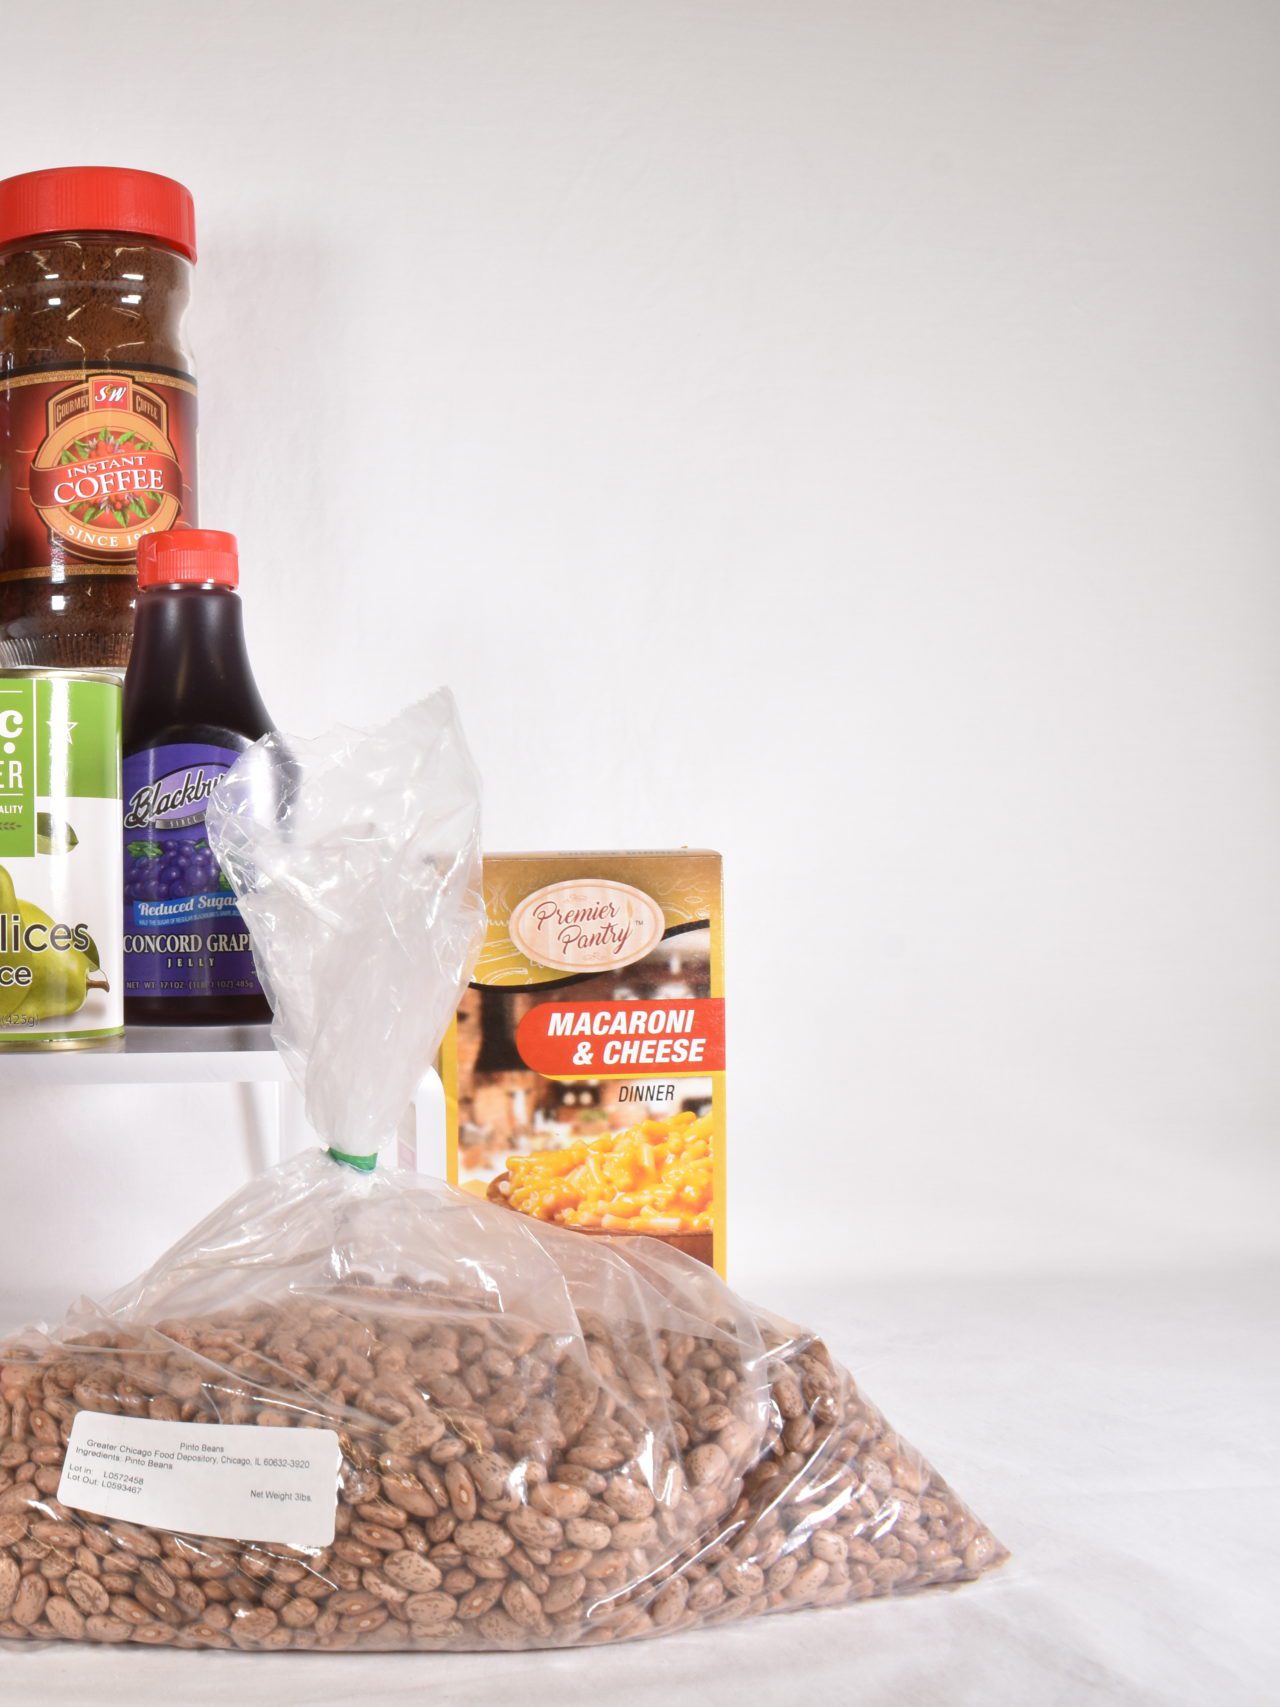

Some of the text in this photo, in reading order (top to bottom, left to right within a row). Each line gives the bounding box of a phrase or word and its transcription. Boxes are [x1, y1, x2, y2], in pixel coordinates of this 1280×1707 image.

[56, 395, 89, 423] GOURMET
[135, 395, 158, 420] COFFEE
[68, 456, 146, 478] INSTANT
[54, 469, 164, 503] COFFEE
[67, 525, 119, 547] SINCE
[138, 898, 194, 916] Reduced
[198, 896, 238, 910] Sugar
[532, 900, 621, 932] Premier
[123, 935, 202, 953] CONCORD
[558, 919, 634, 955] Pantry
[167, 958, 215, 968] JELLY
[1, 1013, 39, 1027] (425g)
[547, 1009, 695, 1037] MACARONI
[572, 1039, 706, 1065] & CHEESE
[618, 1084, 675, 1102] DINNER
[76, 1447, 173, 1470] Ingredients: Pinto Beans
[87, 1439, 117, 1451] Greater
[120, 1445, 152, 1457] Chicago
[154, 1450, 174, 1459] Food
[177, 1452, 218, 1464] Depository,
[221, 1456, 252, 1466] Chicago,
[264, 1458, 310, 1469] 60632-3920
[179, 1442, 224, 1453] Pinto Beans
[67, 1473, 142, 1495] Lot Out: L0593467
[69, 1463, 82, 1471] Lot
[104, 1471, 144, 1485] L0572458
[250, 1490, 264, 1498] Net
[265, 1490, 292, 1501] Weight
